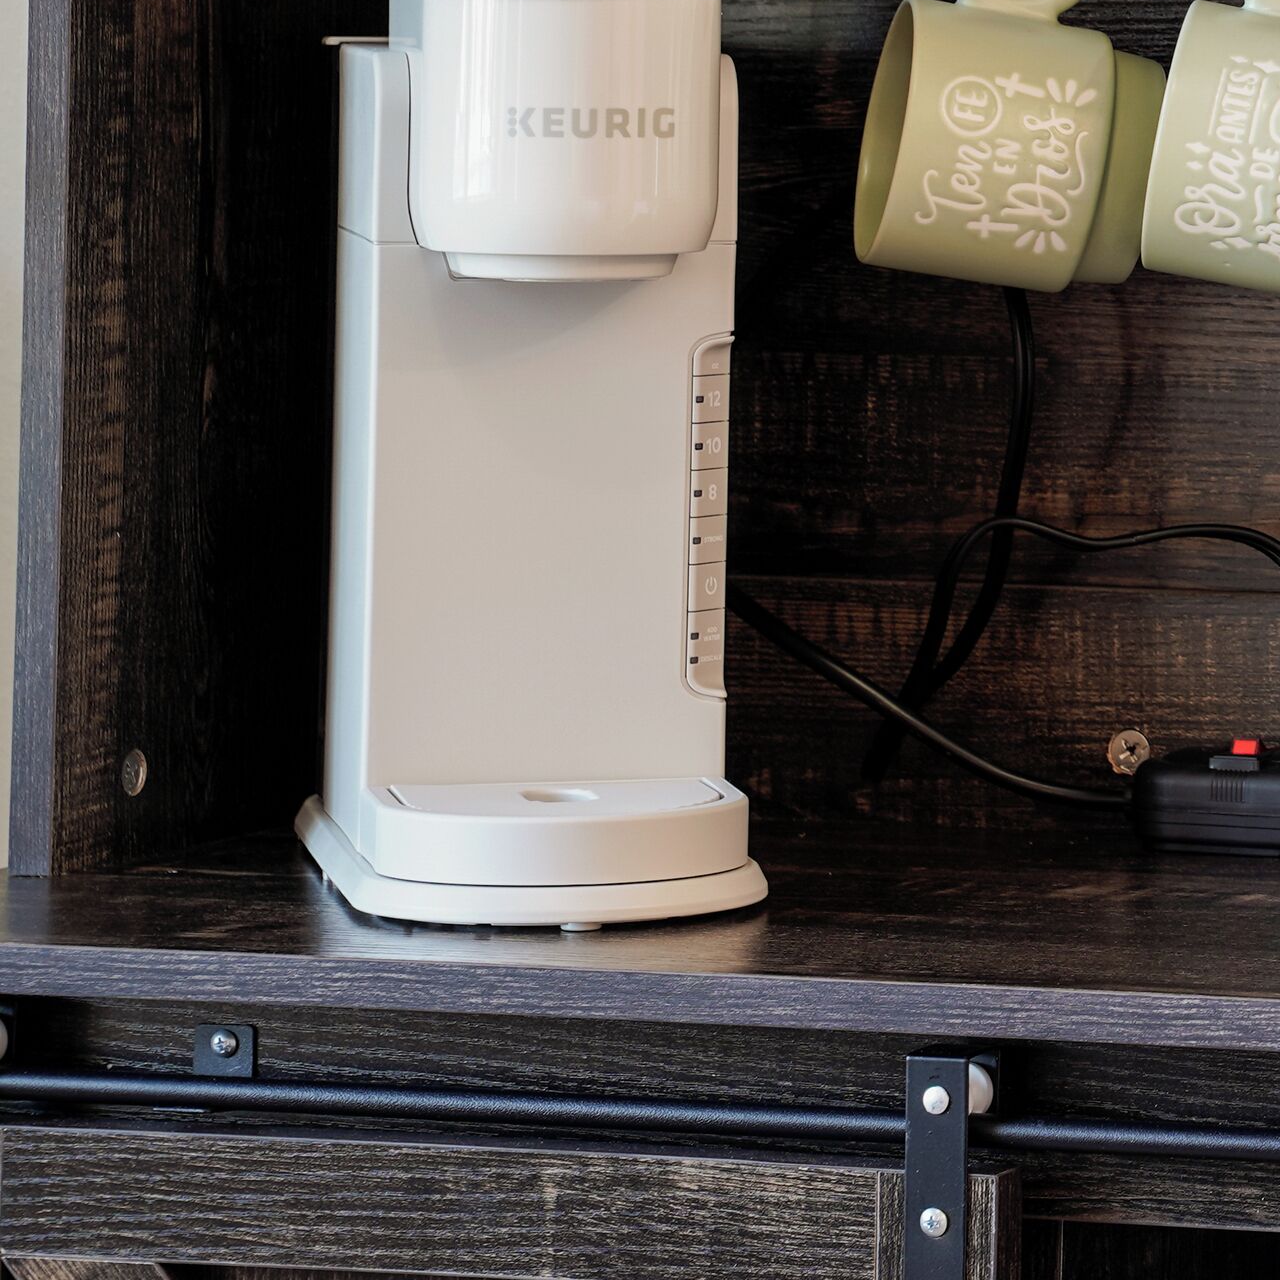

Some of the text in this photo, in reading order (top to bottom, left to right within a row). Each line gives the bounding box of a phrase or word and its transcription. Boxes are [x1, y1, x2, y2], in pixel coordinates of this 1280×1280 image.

[507, 106, 676, 139] KEURIG
[1216, 69, 1259, 144] ANTES
[914, 89, 992, 224] Ten FE
[993, 138, 1021, 174] EN
[1250, 147, 1279, 181] DE
[708, 390, 721, 407] 12
[706, 436, 722, 455] 10
[708, 483, 718, 500] 8
